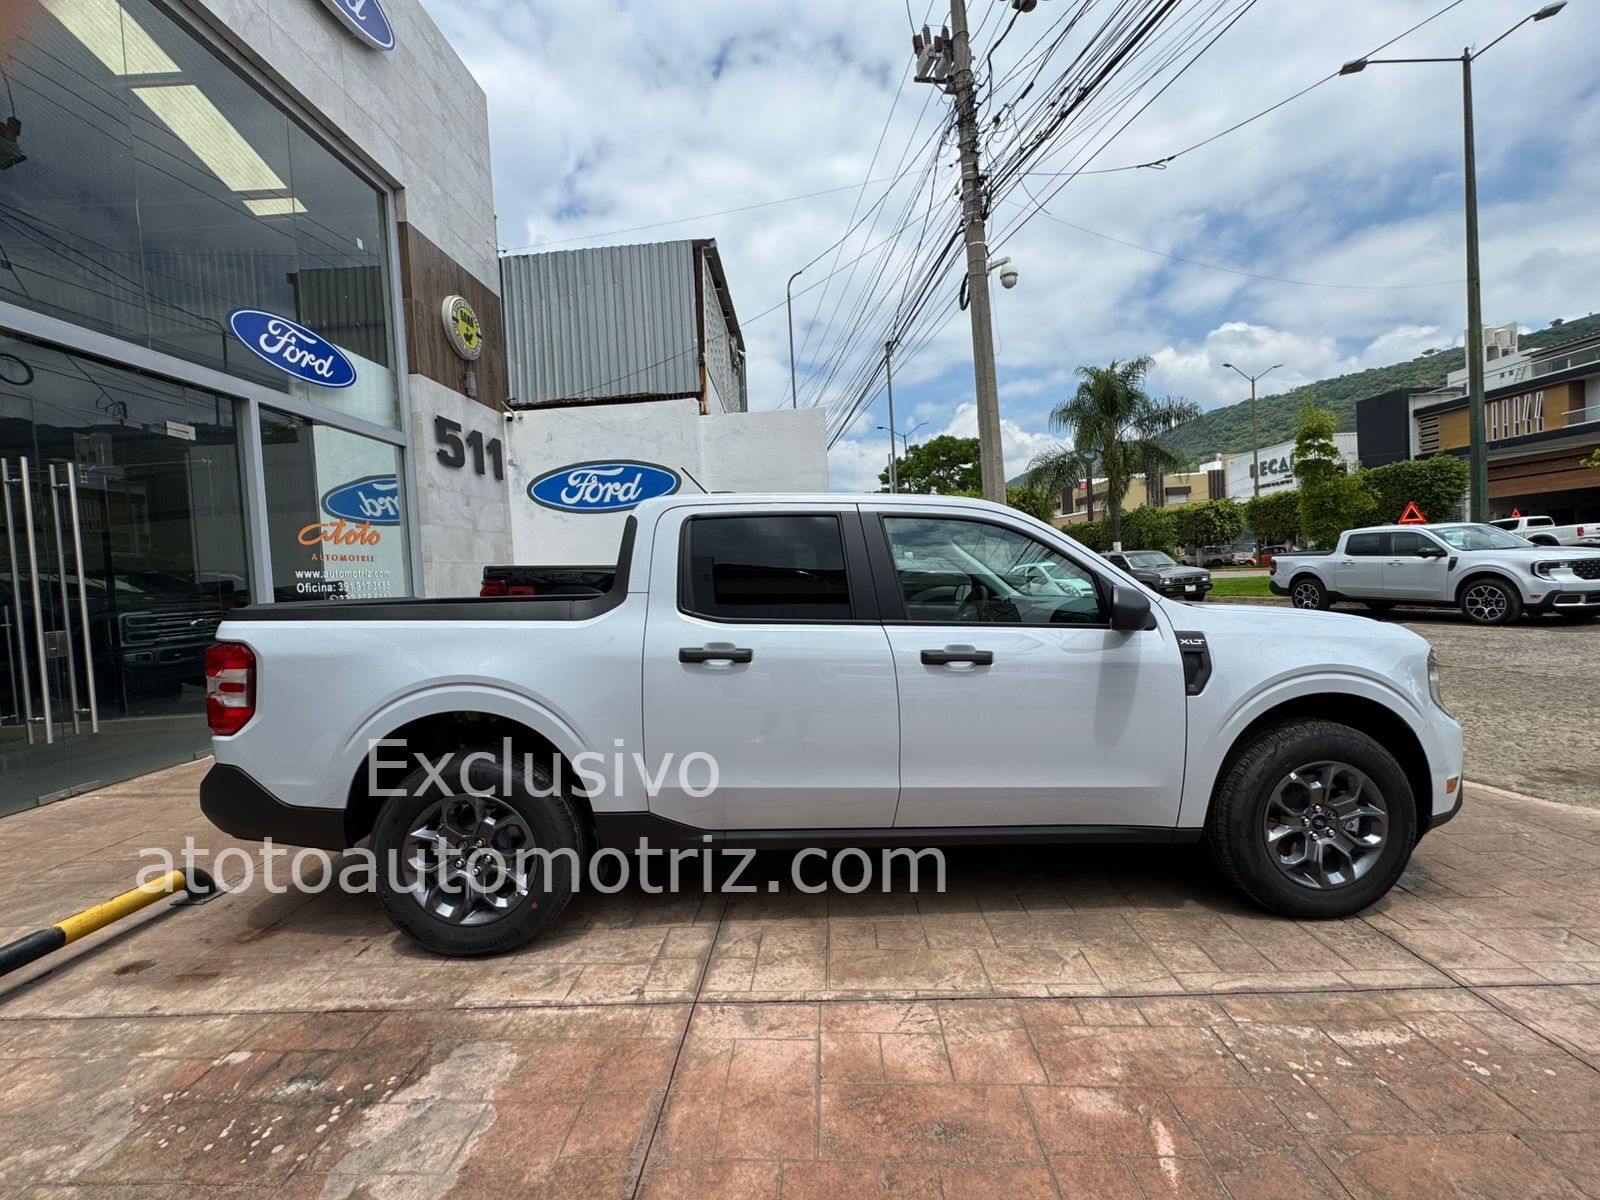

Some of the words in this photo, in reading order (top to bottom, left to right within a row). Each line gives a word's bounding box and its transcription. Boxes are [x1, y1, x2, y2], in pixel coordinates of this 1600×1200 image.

[259, 320, 334, 378] Ford
[435, 415, 504, 480] 511
[560, 467, 642, 504] Ford
[311, 553, 375, 562] AUTOMOTRIZ
[295, 569, 391, 579] www.automotriz.com
[296, 582, 336, 593] Oficina:
